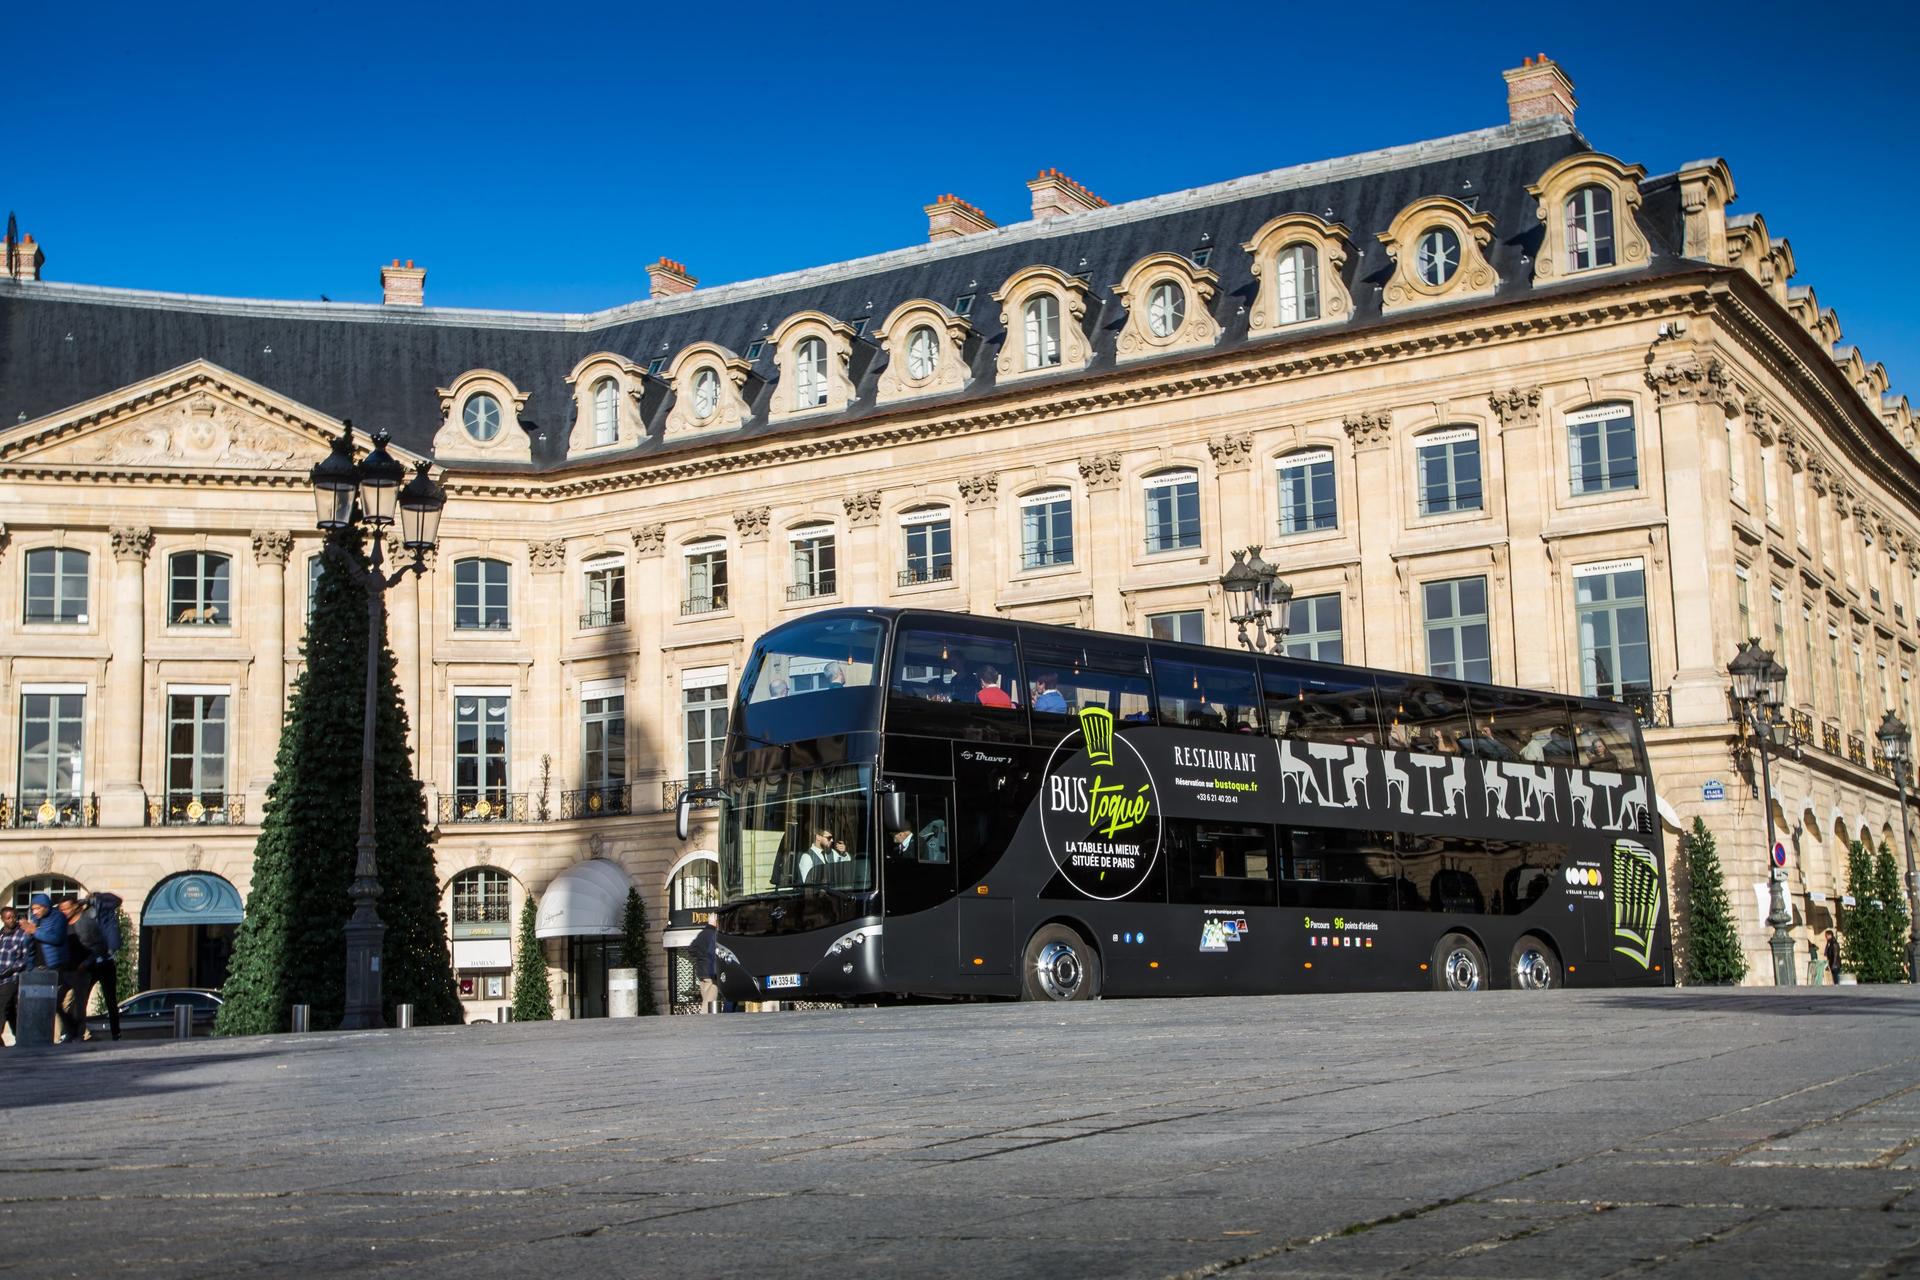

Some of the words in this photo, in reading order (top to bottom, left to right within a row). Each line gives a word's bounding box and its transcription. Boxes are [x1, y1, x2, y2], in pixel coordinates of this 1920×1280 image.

[1578, 409, 1625, 420] schiaparelli
[1427, 432, 1470, 442] schiaparelli
[1286, 453, 1326, 464] schiaparelli
[1584, 561, 1632, 572] schiaparelli
[975, 751, 1007, 763] Bravo
[1174, 746, 1256, 772] RESTAURANT
[1175, 777, 1205, 788] Réservation
[1214, 779, 1258, 792] bustoque.fr
[1050, 775, 1088, 813] BUS
[1089, 775, 1150, 839] toqué
[1065, 841, 1077, 853] LA
[1077, 842, 1103, 854] TABLE
[1103, 843, 1114, 855] LA
[1115, 844, 1140, 856] MIEUX
[1072, 853, 1100, 867] SITUÉE
[1100, 856, 1112, 868] DE
[1112, 857, 1135, 869] PARIS
[1304, 916, 1310, 929] 3
[1310, 920, 1330, 929] Parcours
[1334, 917, 1344, 929] 96
[1344, 921, 1358, 931] points
